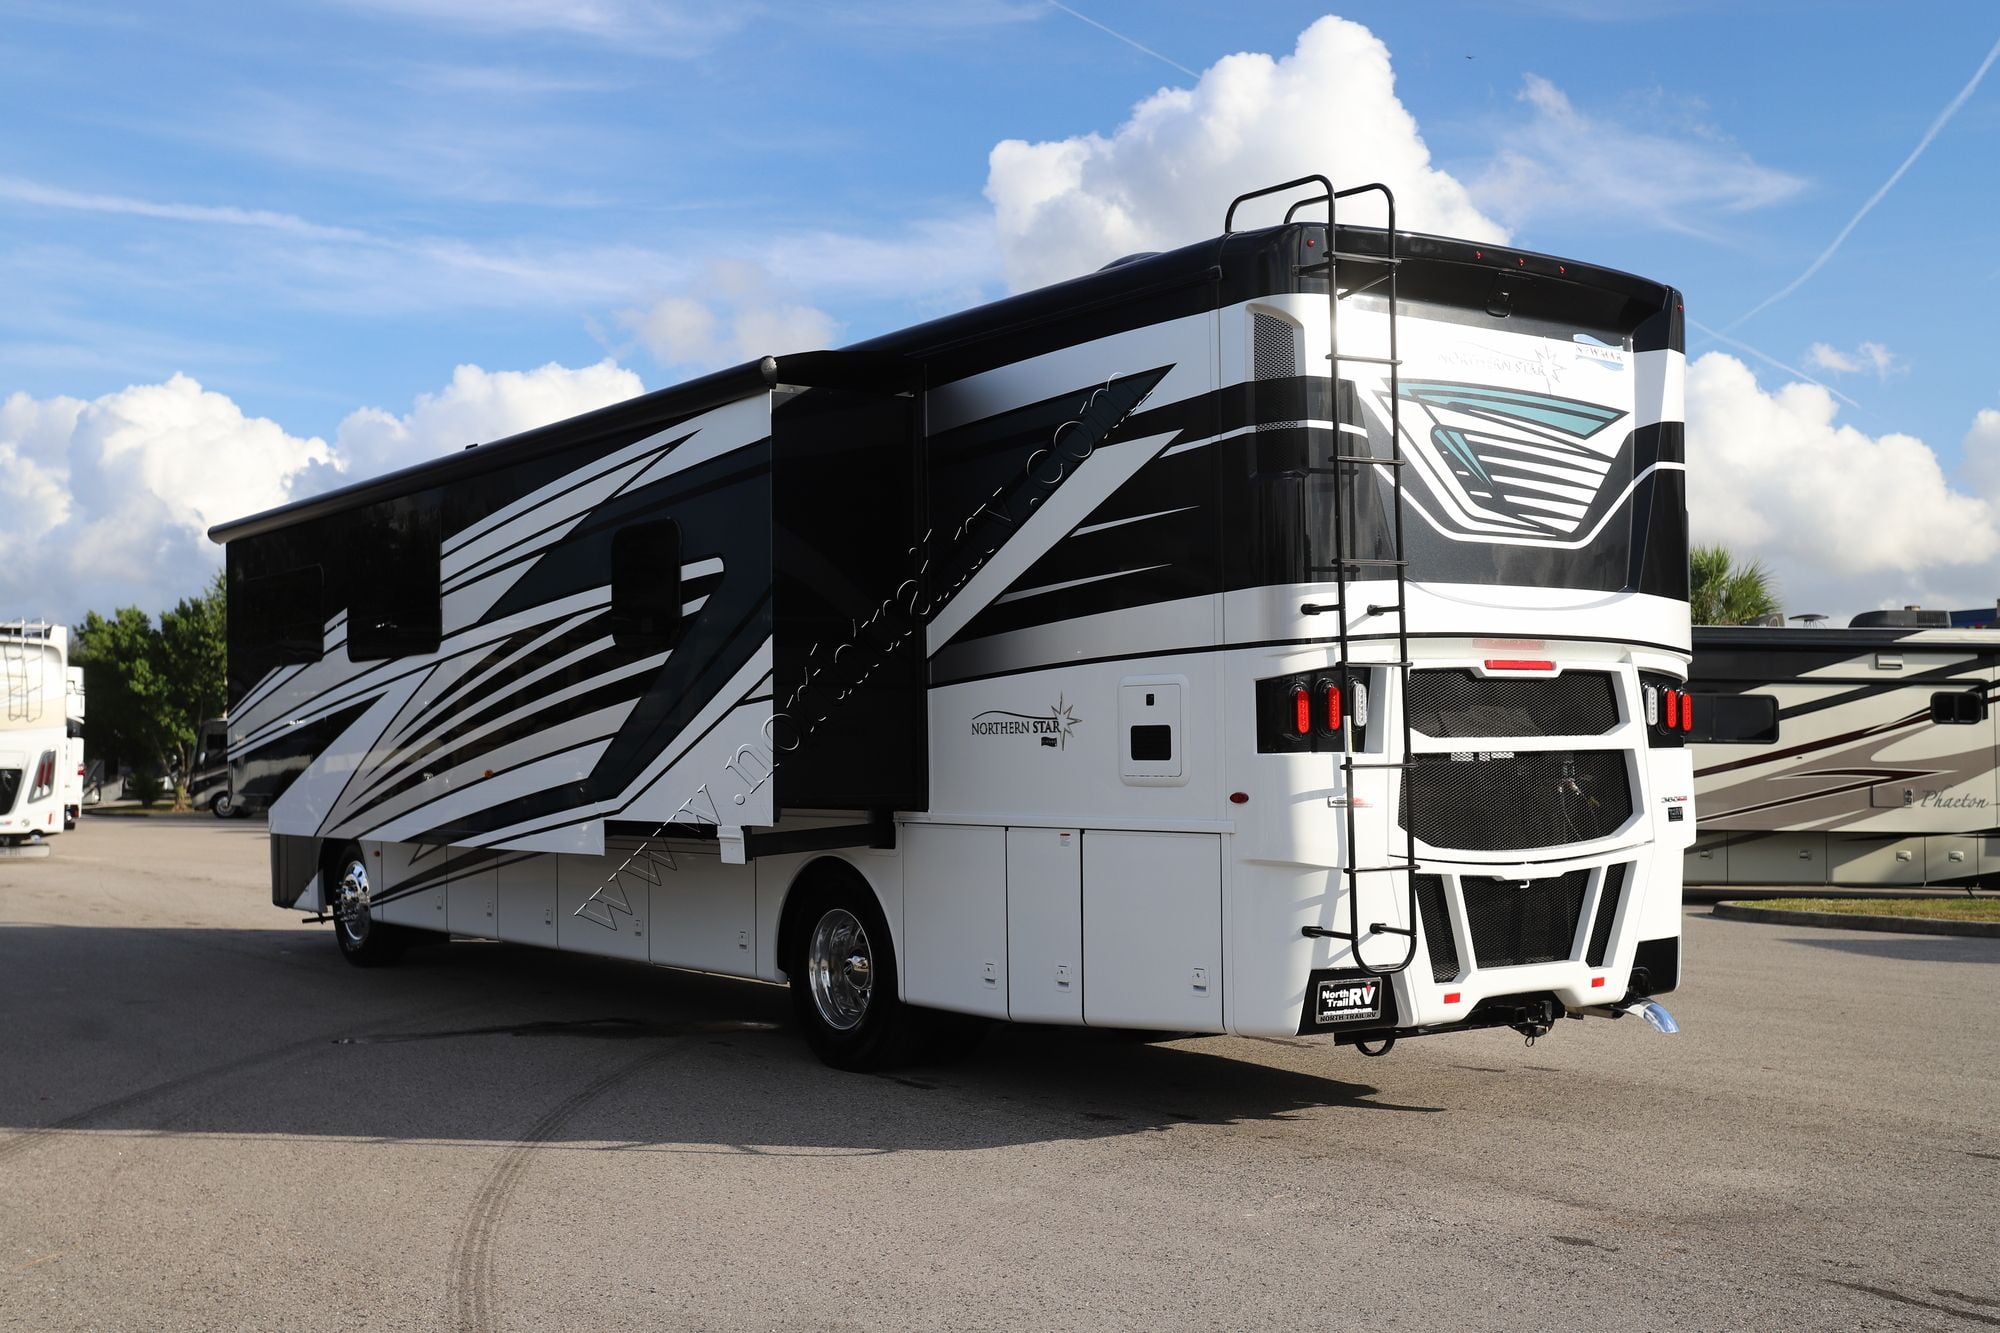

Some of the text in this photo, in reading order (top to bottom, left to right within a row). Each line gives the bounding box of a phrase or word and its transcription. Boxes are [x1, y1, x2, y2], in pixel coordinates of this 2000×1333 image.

[971, 720, 1060, 735] NORTHERN STAR
[1920, 784, 1989, 808] Phaeton
[1322, 986, 1376, 1006] North RV
[1327, 998, 1349, 1007] Trail
